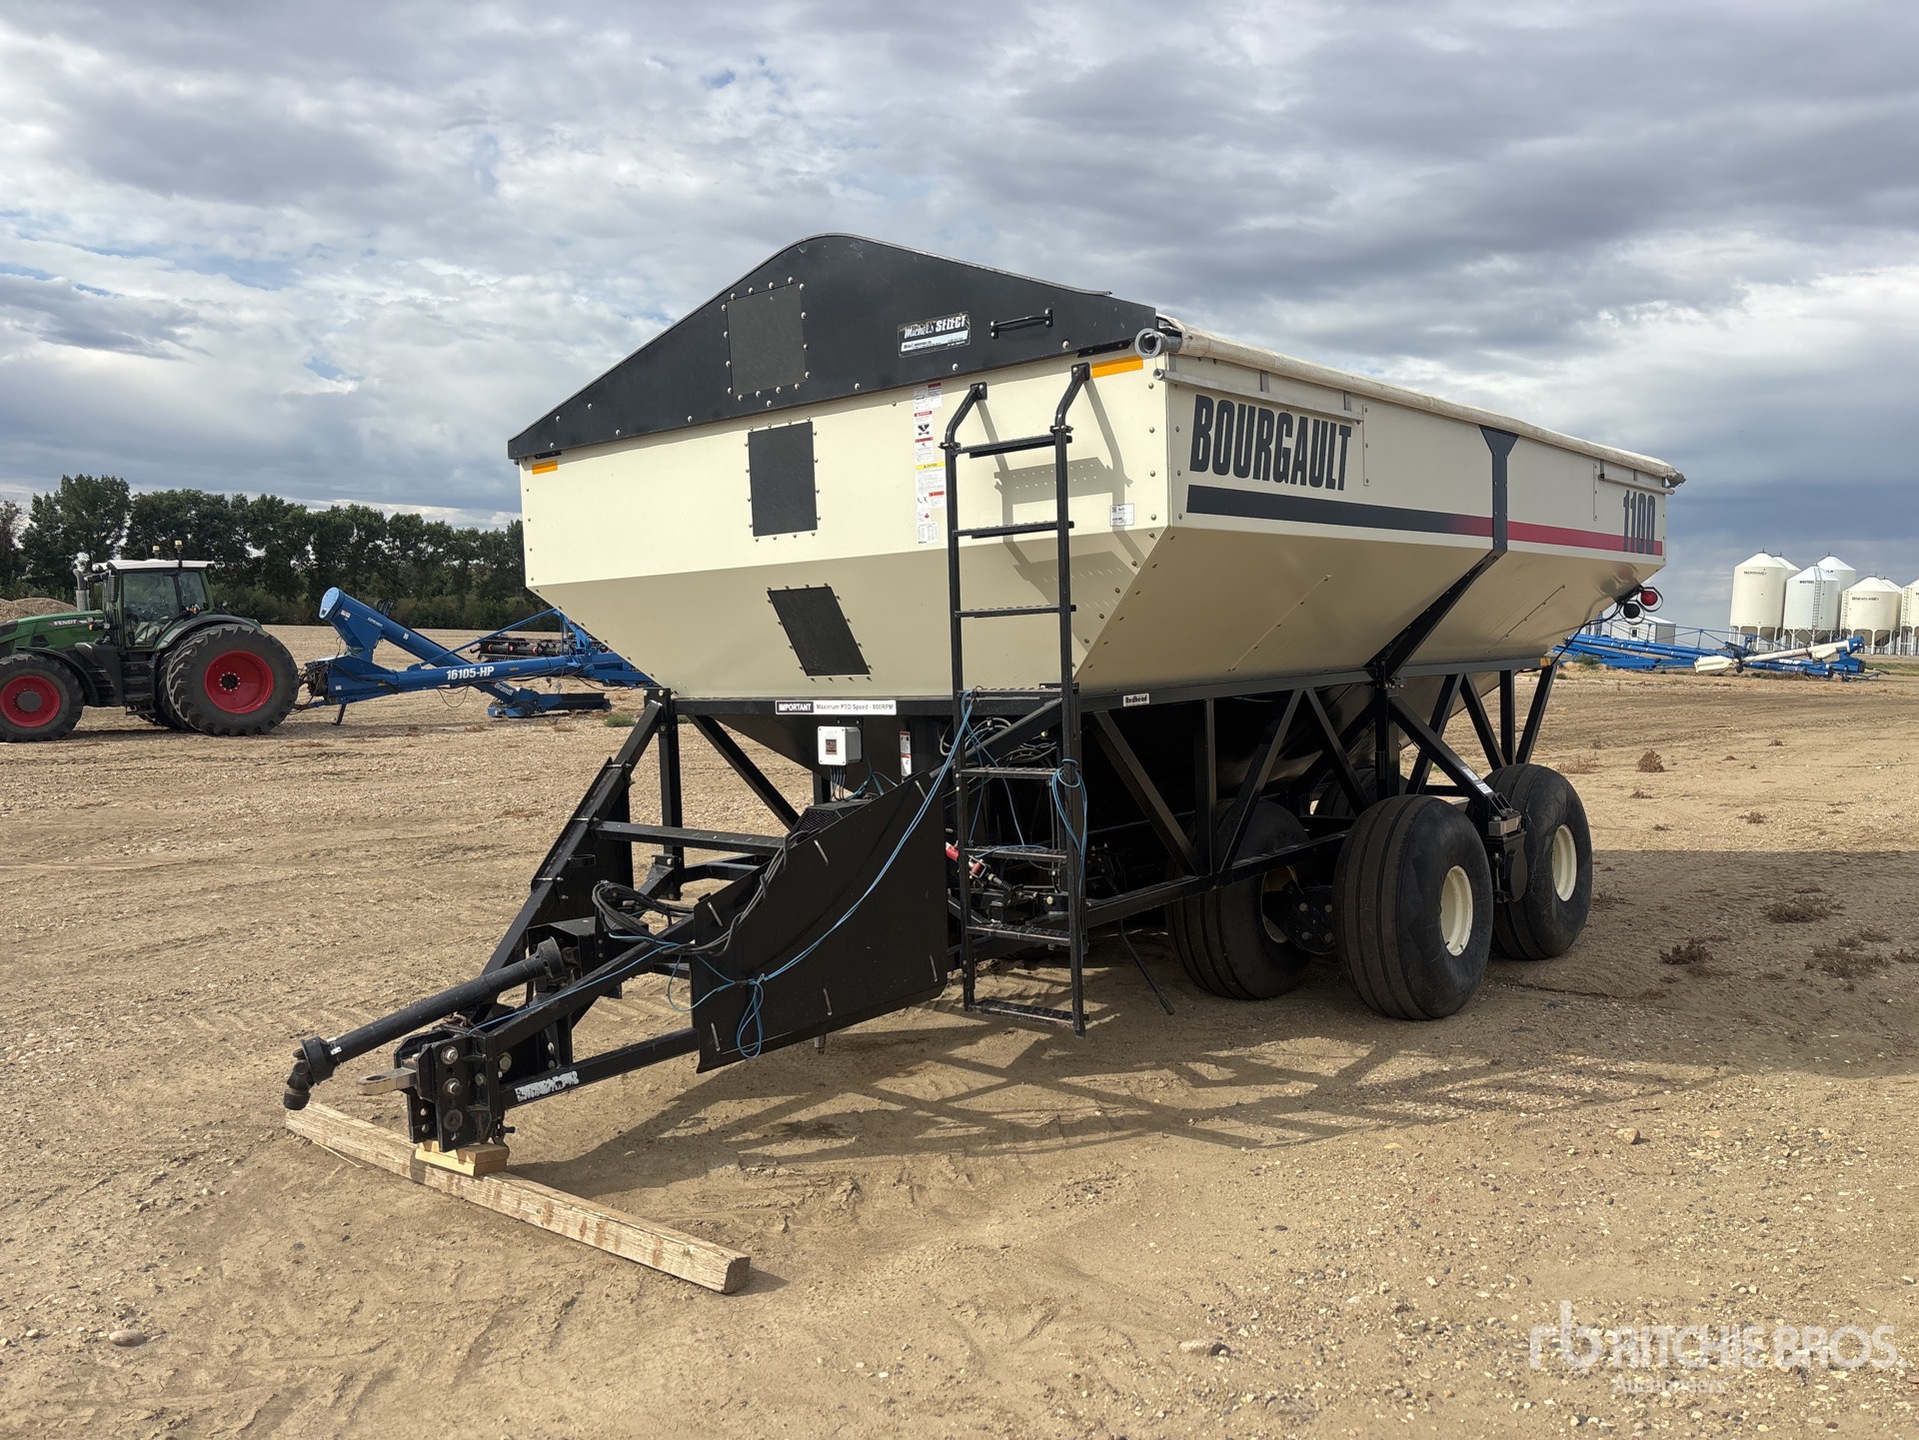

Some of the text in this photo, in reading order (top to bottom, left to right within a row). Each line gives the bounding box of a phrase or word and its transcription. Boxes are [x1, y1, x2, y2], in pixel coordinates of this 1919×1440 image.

[935, 315, 967, 332] SELECT
[1189, 394, 1352, 491] BOURGAULT
[1623, 489, 1656, 555] 1100
[446, 665, 495, 681] 16105-HP
[778, 703, 812, 712] IMPORTANT
